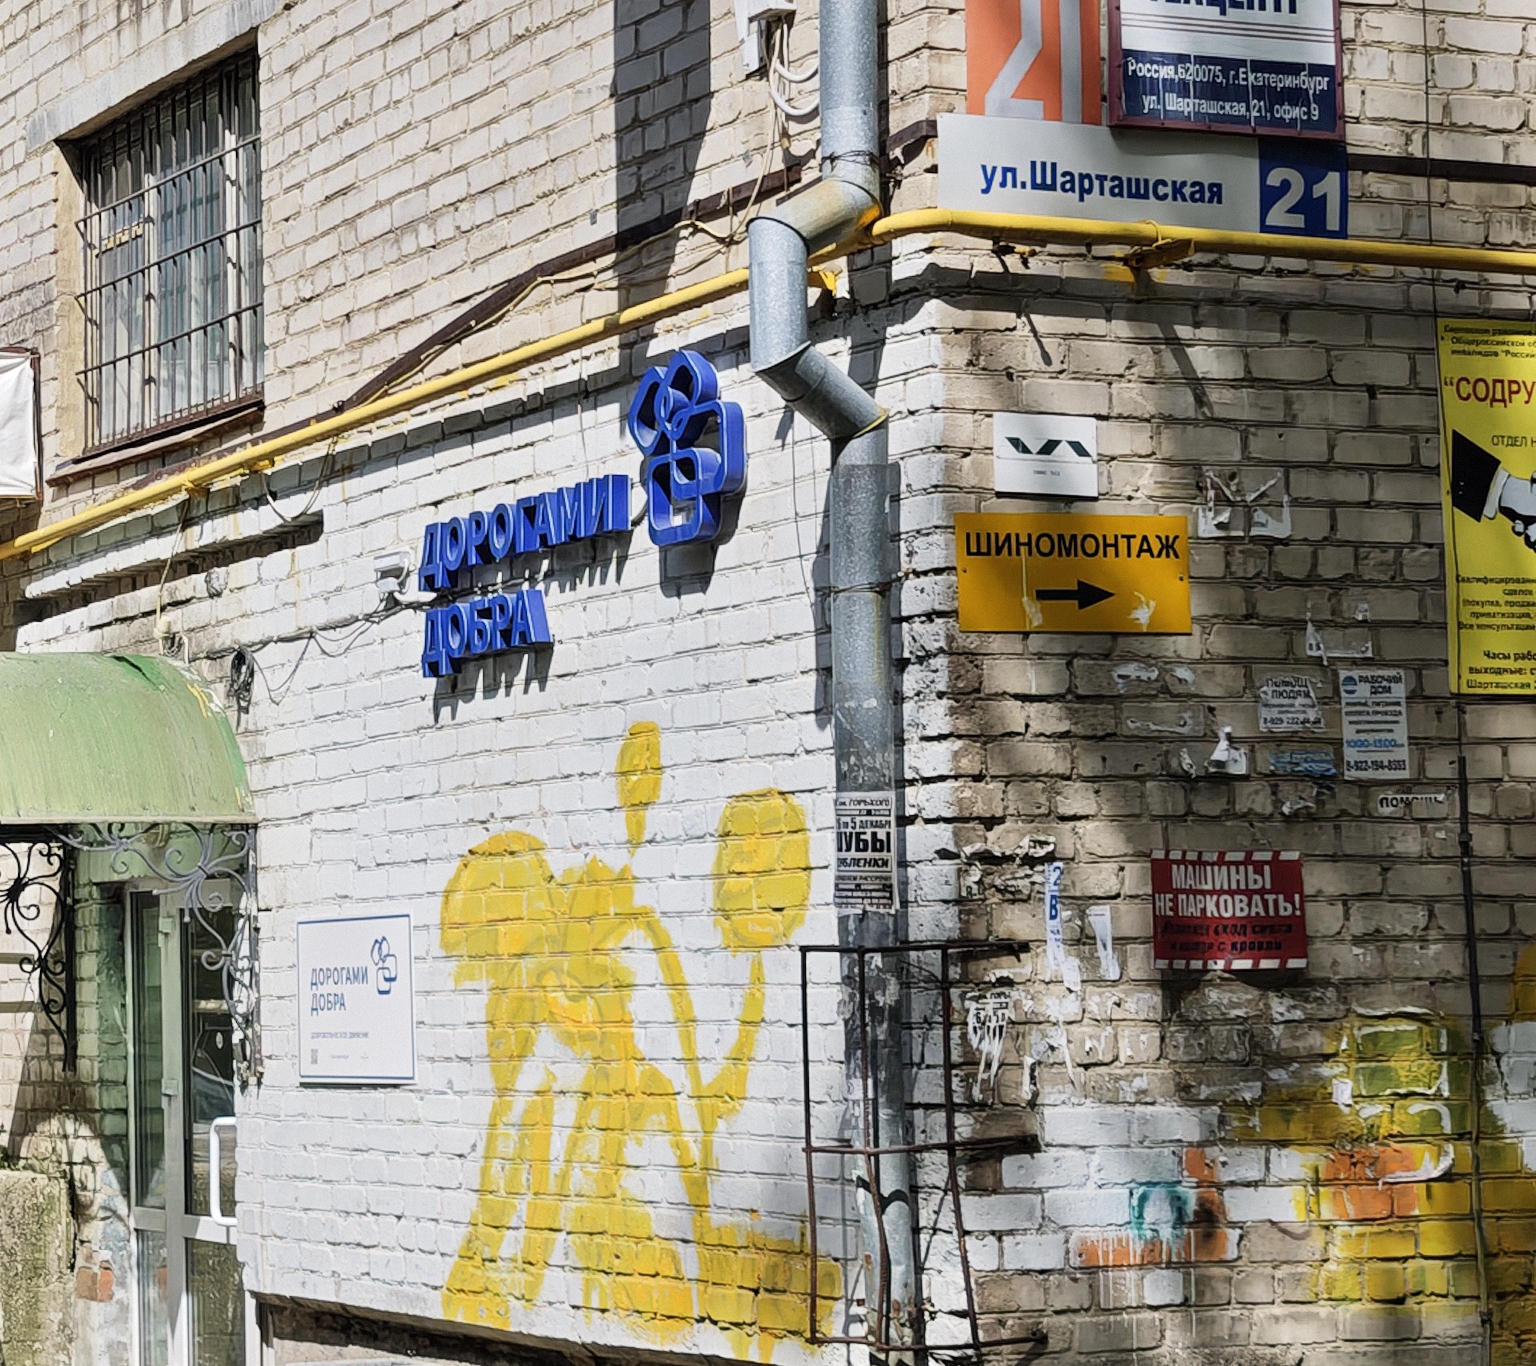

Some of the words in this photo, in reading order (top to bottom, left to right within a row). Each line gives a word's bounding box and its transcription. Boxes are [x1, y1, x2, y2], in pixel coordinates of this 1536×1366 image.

[1273, 102, 1308, 123] офис
[1310, 104, 1319, 120] 9
[1264, 167, 1343, 232] 21
[1491, 434, 1527, 448] ОТДЕЛ
[419, 474, 631, 591] ДОРОГАМИ
[965, 531, 1181, 561] ШИНОМОНТАЖ
[422, 589, 552, 677] ДОБРА
[1171, 863, 1272, 890] МАШИНЫ
[1154, 892, 1174, 917] НЕ
[1177, 893, 1301, 918] ПАРКОВАТЬ!
[310, 966, 369, 991] ДОРОГАМИ
[311, 993, 346, 1016] ДОБРА
